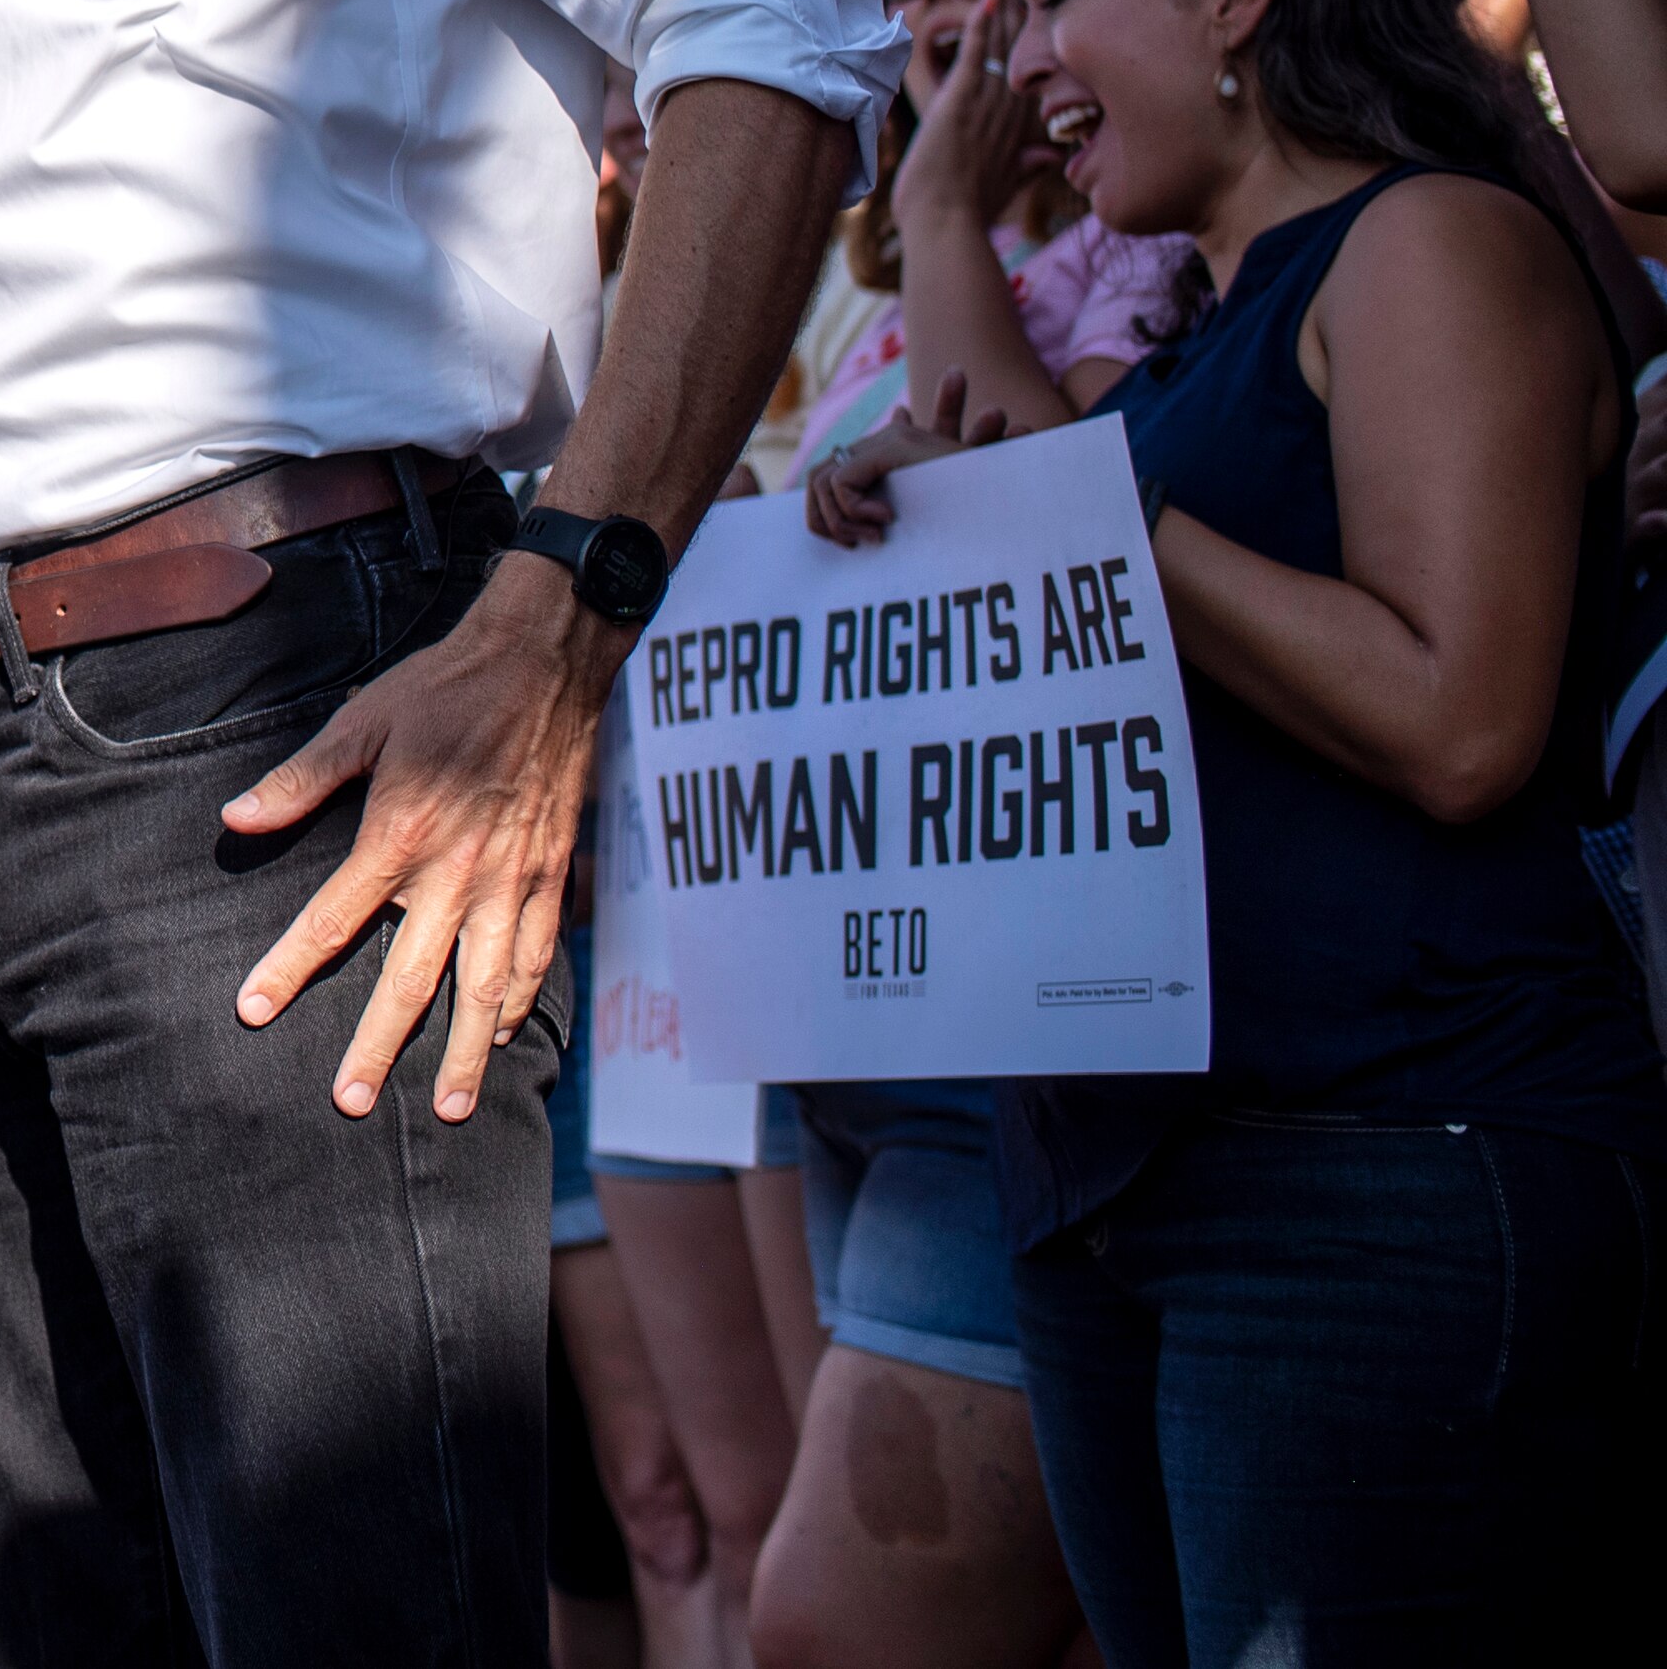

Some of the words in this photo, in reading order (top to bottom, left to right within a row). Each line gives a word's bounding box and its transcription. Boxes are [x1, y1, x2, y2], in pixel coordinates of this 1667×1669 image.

[650, 617, 802, 728] REPRO
[822, 582, 1022, 705] RIGHTS
[1042, 556, 1146, 676] ARE
[658, 750, 877, 889] HUMAN
[909, 715, 1171, 867] RIGHTS
[844, 908, 927, 978] BETO
[1070, 988, 1083, 998] Paid
[1103, 987, 1117, 996] Beto
[1118, 987, 1127, 995] for
